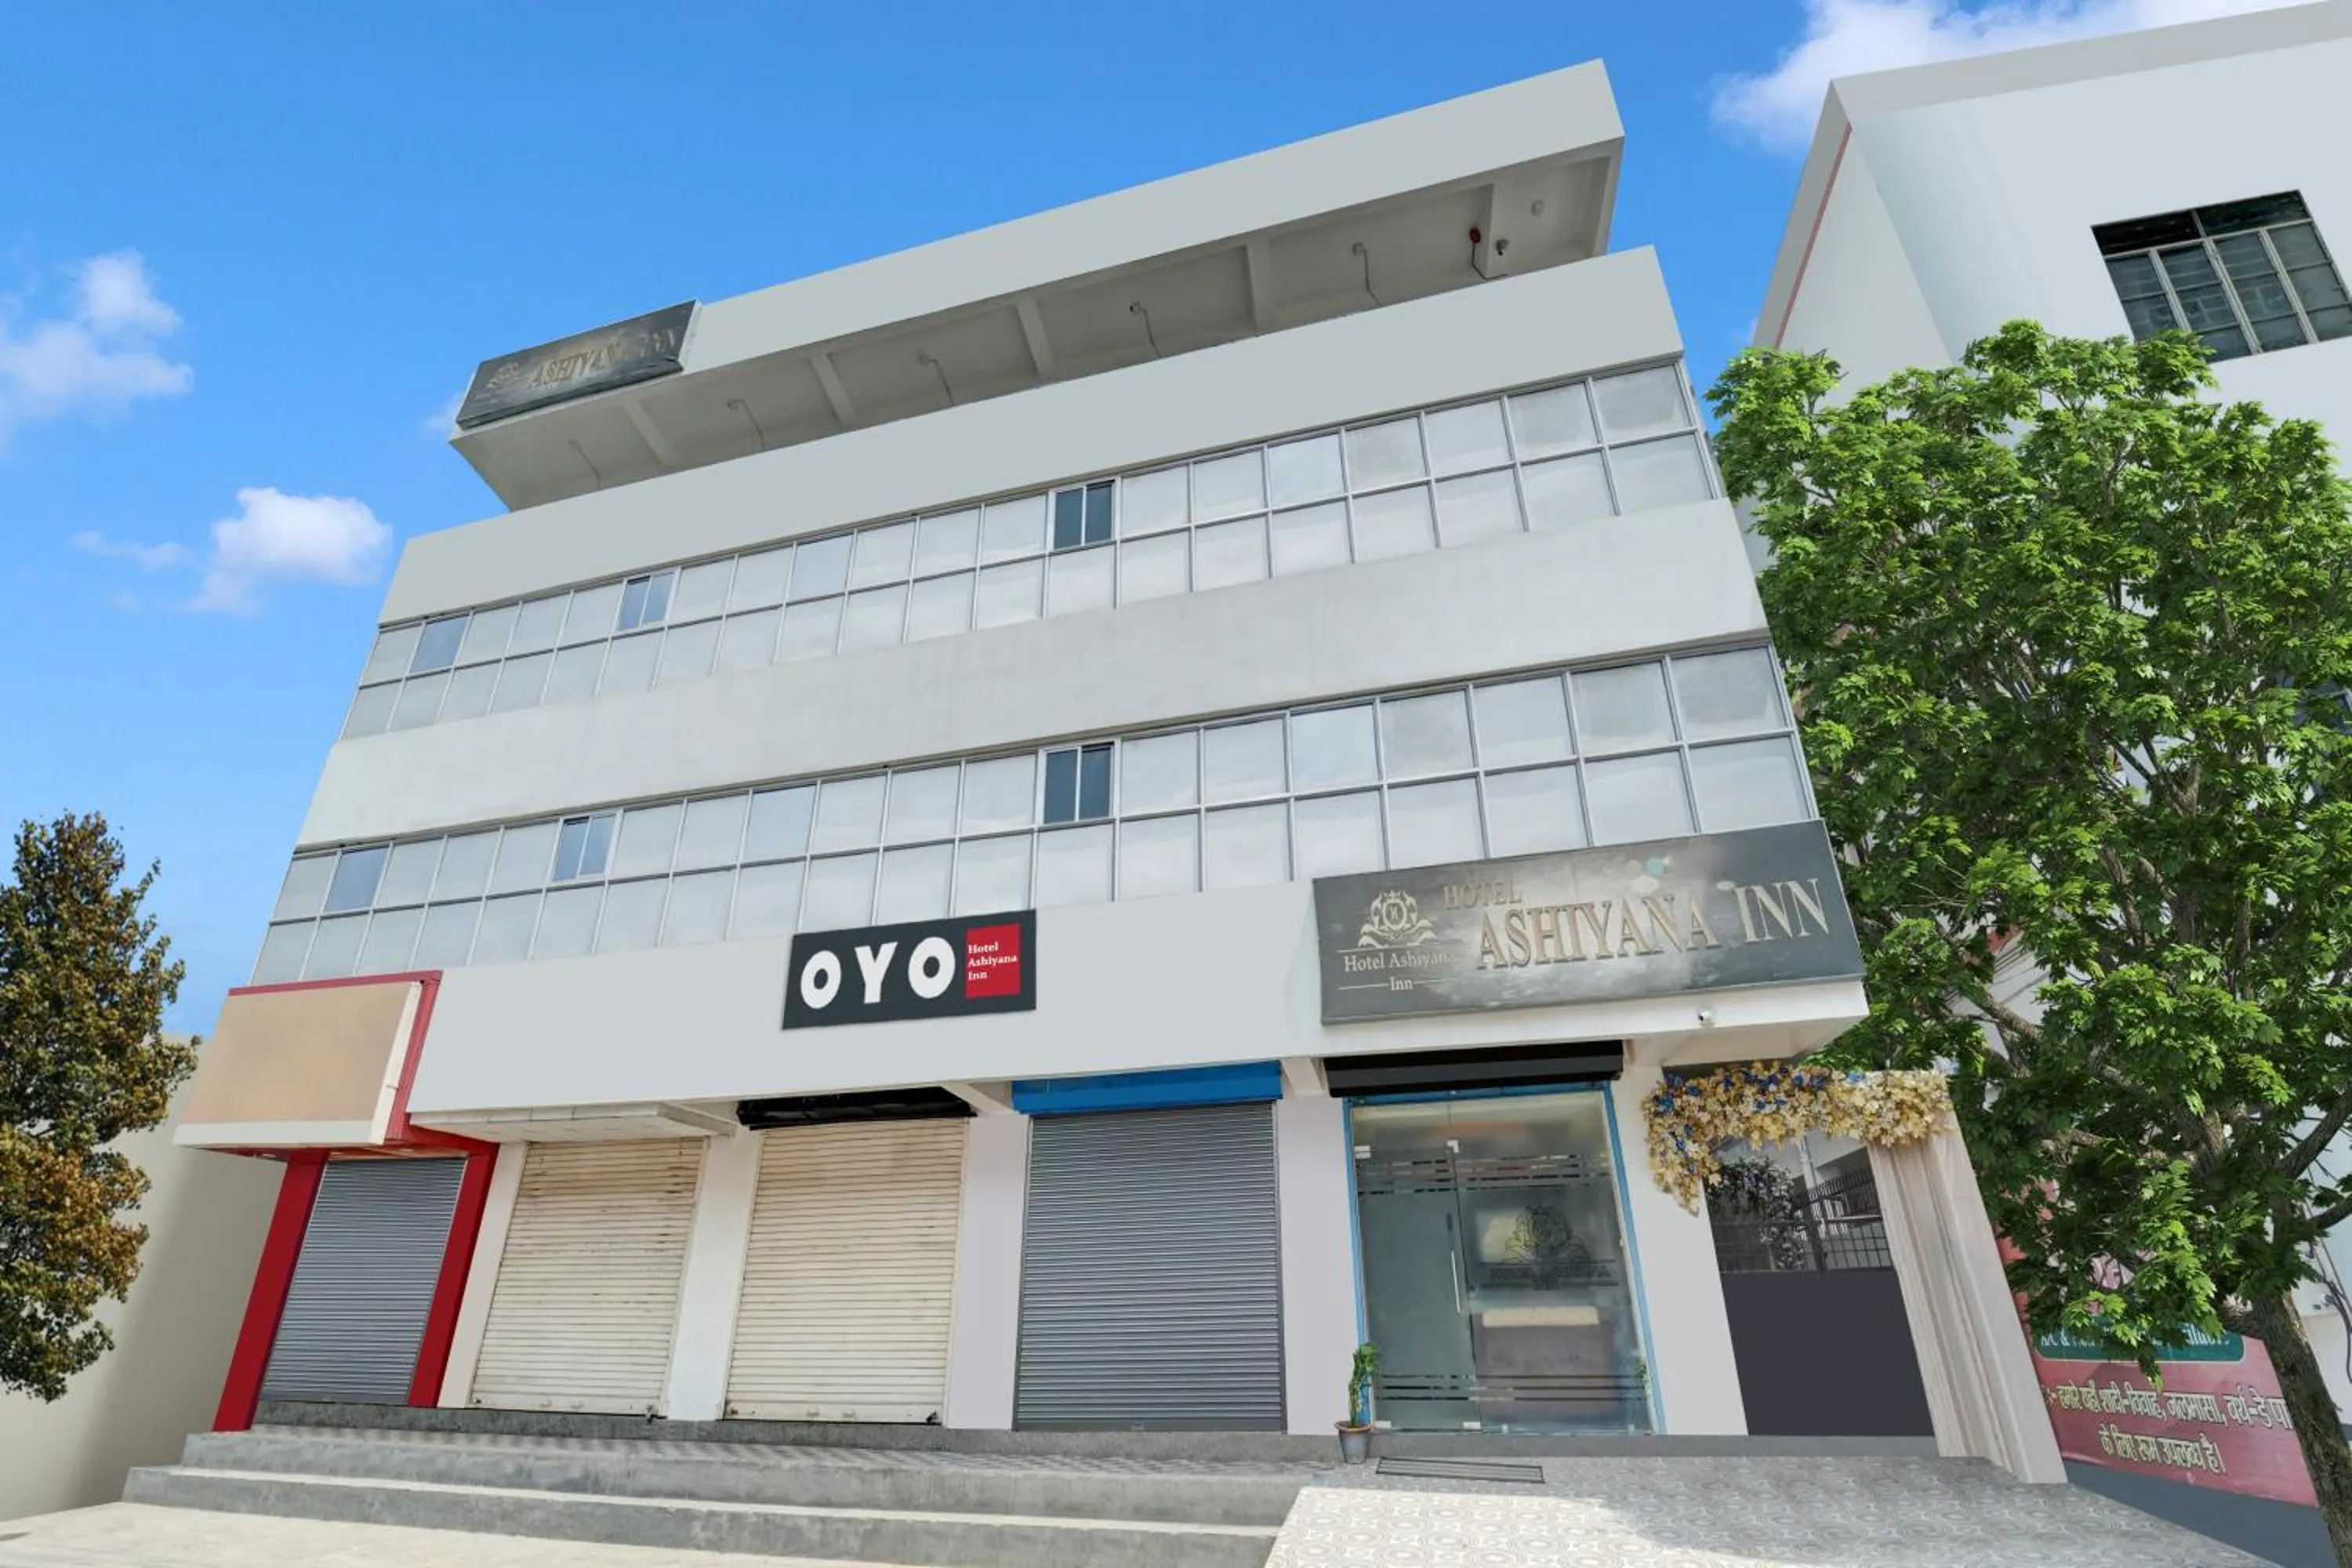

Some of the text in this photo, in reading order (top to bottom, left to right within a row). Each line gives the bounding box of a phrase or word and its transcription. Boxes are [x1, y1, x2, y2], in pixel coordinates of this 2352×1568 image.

[1443, 880, 1523, 910] HOTEL
[1476, 879, 1831, 971] ASHIYANA INN
[967, 942, 999, 954] Hotel
[967, 954, 1018, 968] Ashiyana
[1344, 949, 1455, 972] Hotel Ashiyana
[800, 936, 956, 1010] OYO
[967, 969, 988, 981] Inn
[1389, 976, 1415, 991] Inn
